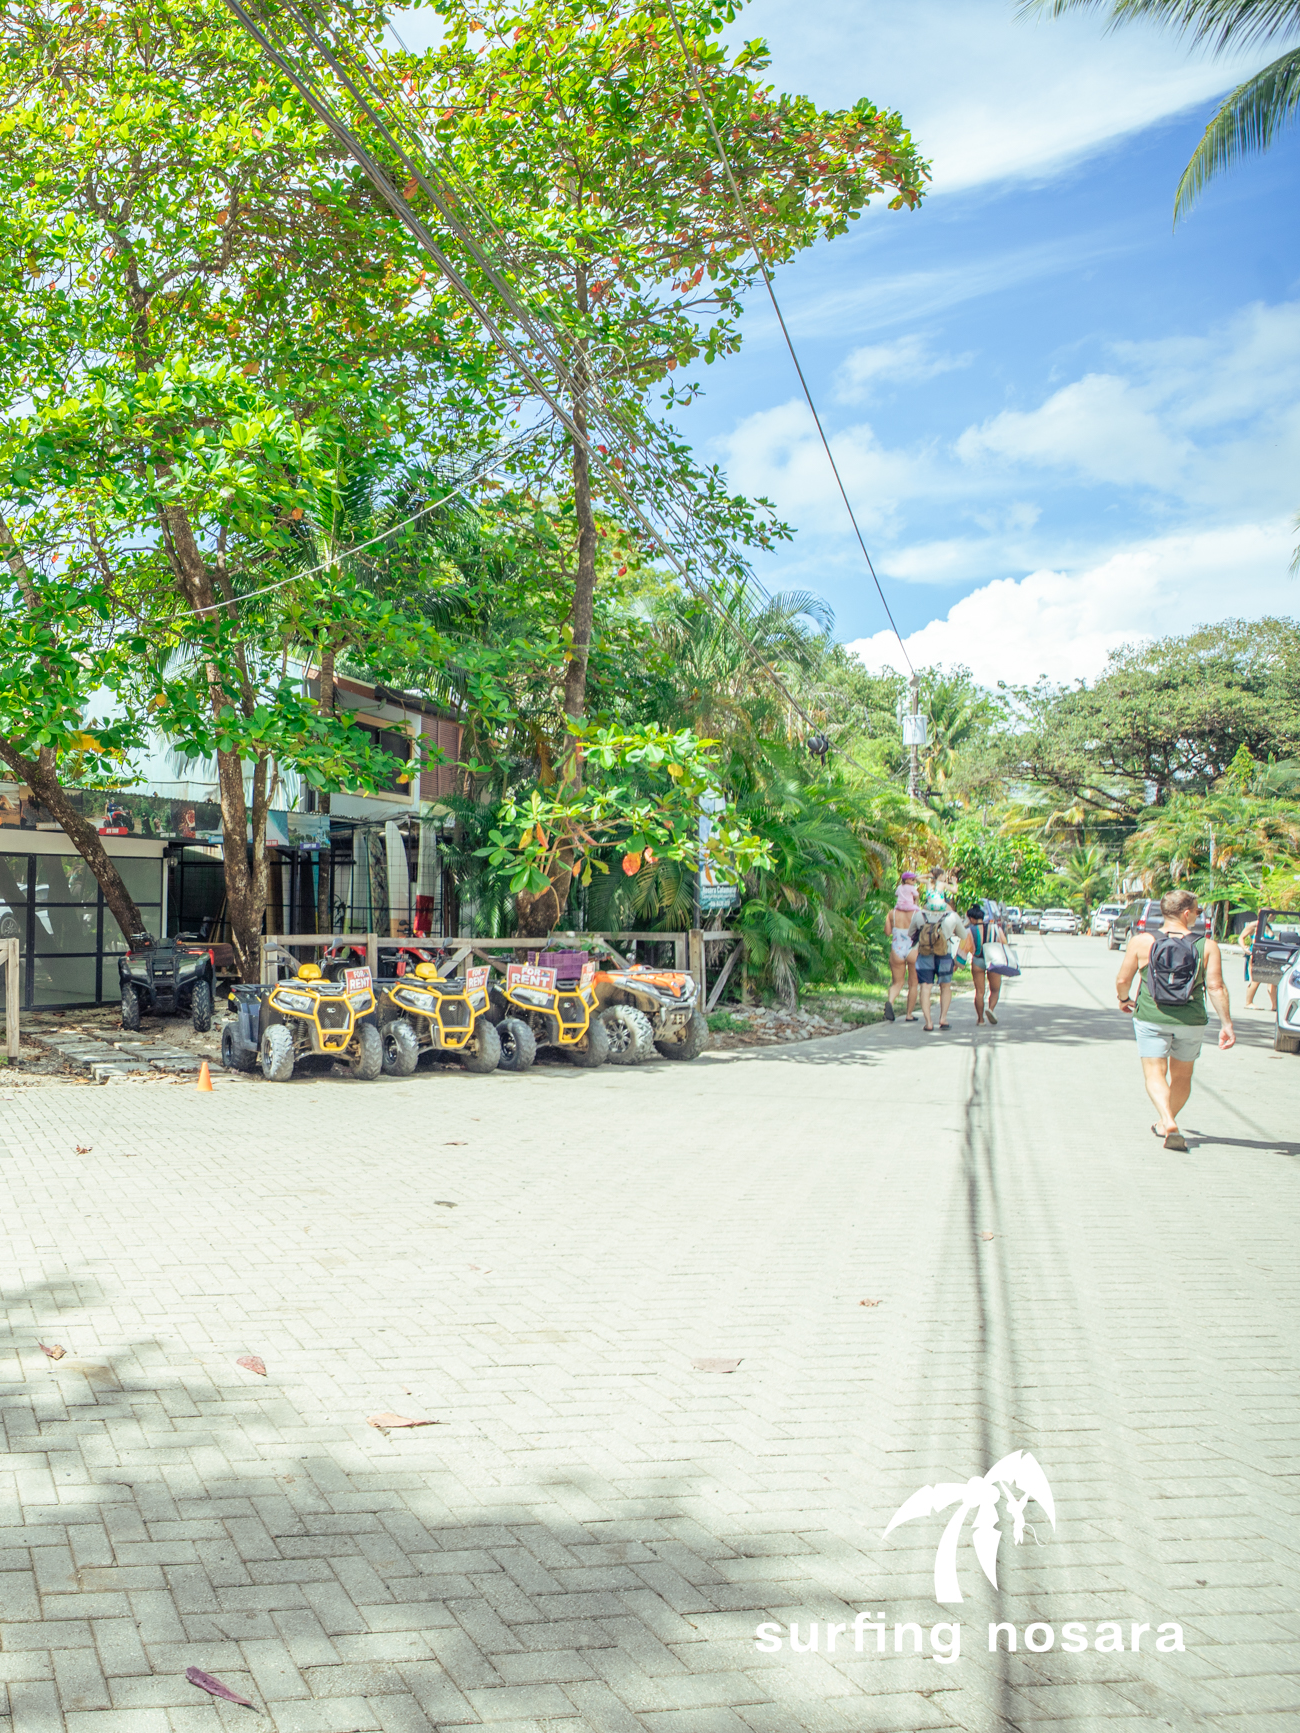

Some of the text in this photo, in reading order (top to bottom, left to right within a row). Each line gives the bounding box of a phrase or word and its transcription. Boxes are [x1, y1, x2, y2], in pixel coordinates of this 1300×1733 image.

[353, 969, 365, 978] FOR
[472, 968, 482, 977] FOR
[521, 967, 541, 976] FOR
[350, 977, 370, 990] RENT
[468, 976, 485, 988] RENT
[512, 973, 550, 987] RENT
